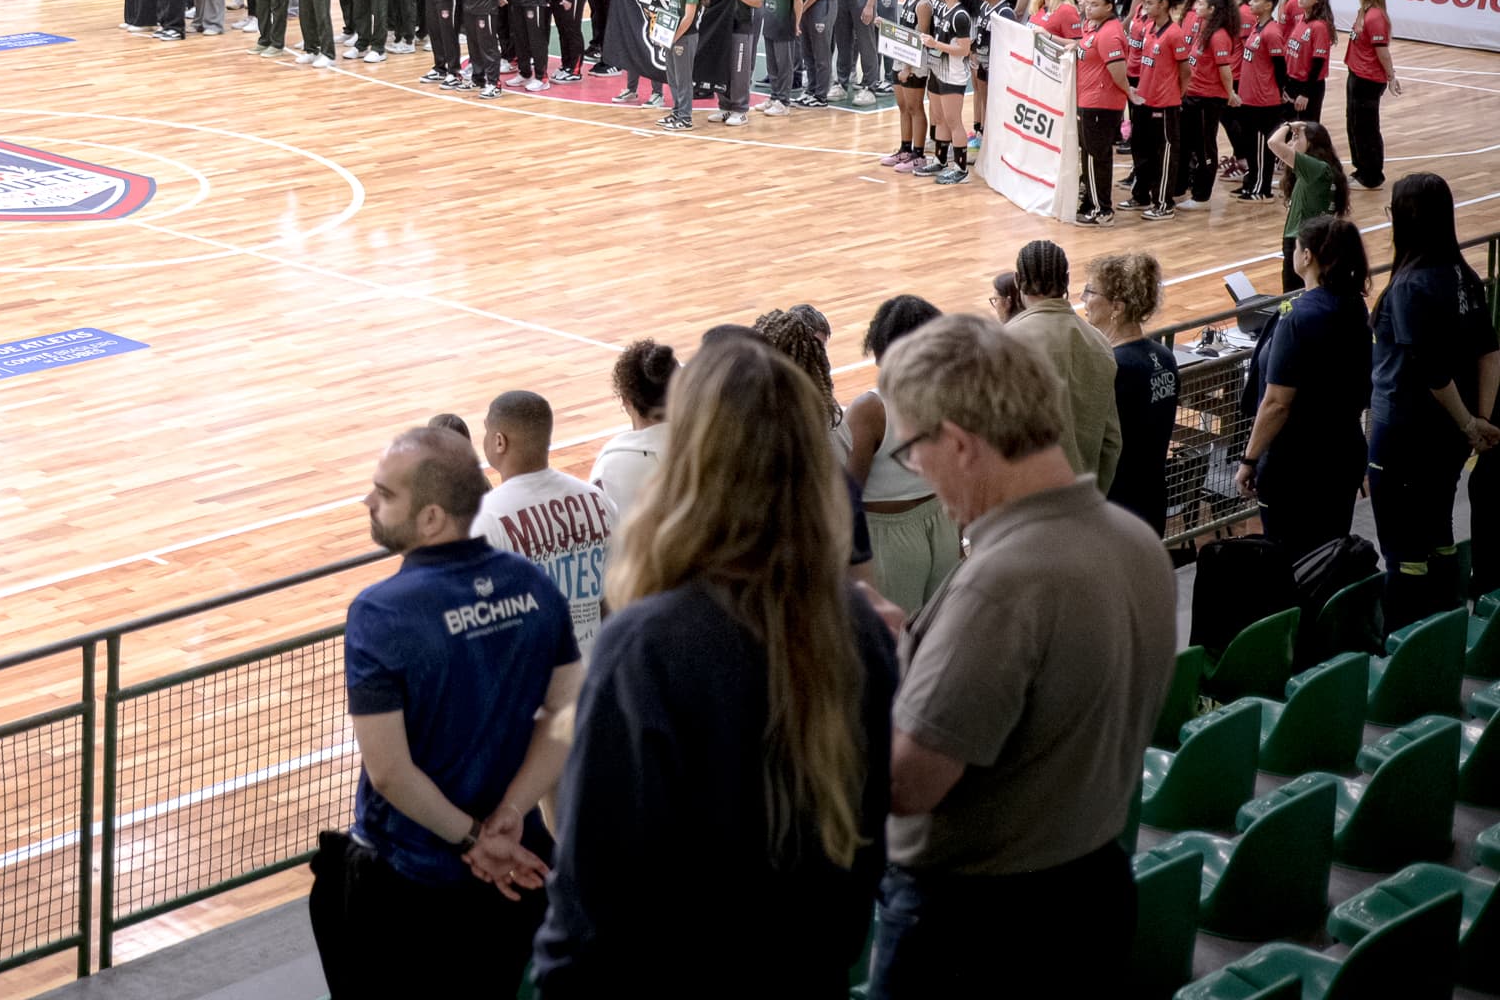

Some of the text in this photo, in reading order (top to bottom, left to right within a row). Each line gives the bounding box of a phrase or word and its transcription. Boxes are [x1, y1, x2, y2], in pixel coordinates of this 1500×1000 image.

[1014, 103, 1055, 139] SESI
[19, 330, 94, 351] ATLETAS
[1150, 371, 1176, 391] SANTO
[499, 491, 612, 559] MUSCLE
[443, 591, 540, 636] BRCHINA
